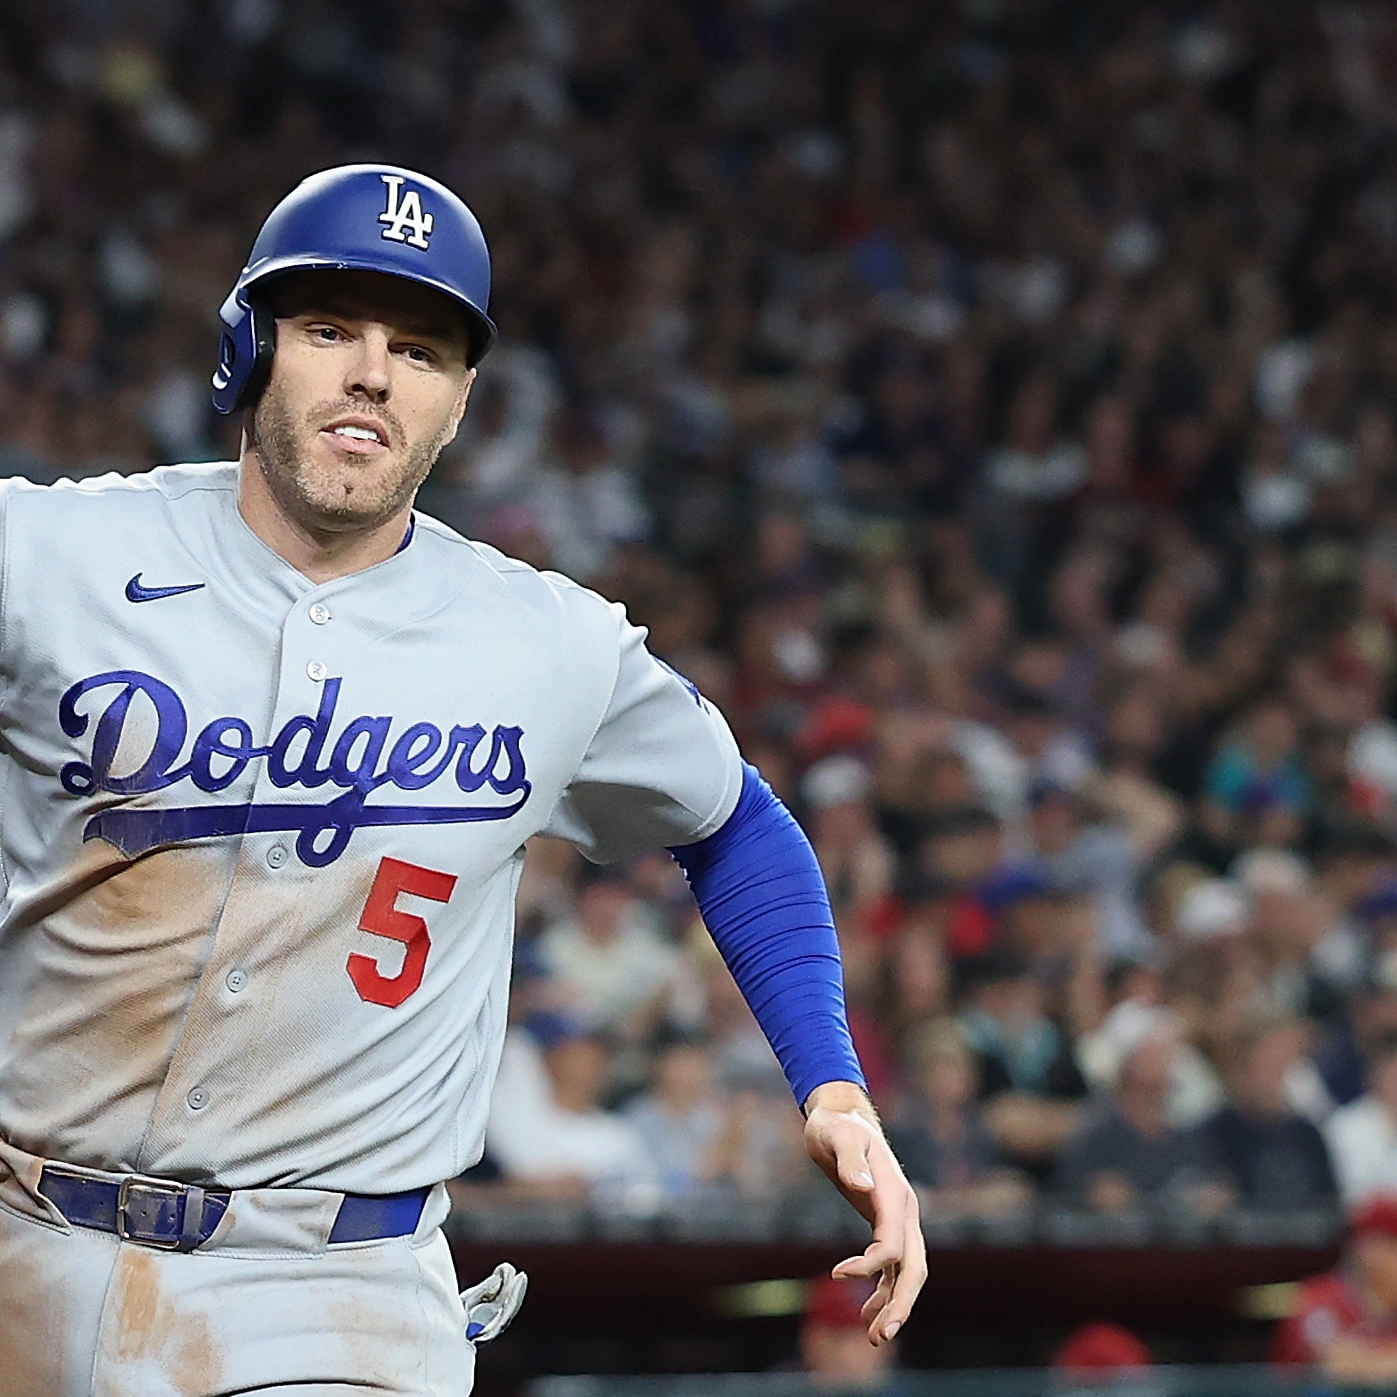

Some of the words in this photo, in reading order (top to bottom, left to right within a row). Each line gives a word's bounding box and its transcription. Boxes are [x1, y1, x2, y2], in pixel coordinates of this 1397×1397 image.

[380, 175, 432, 250] LA
[61, 670, 531, 868] Dodgers
[347, 857, 457, 1008] 5
